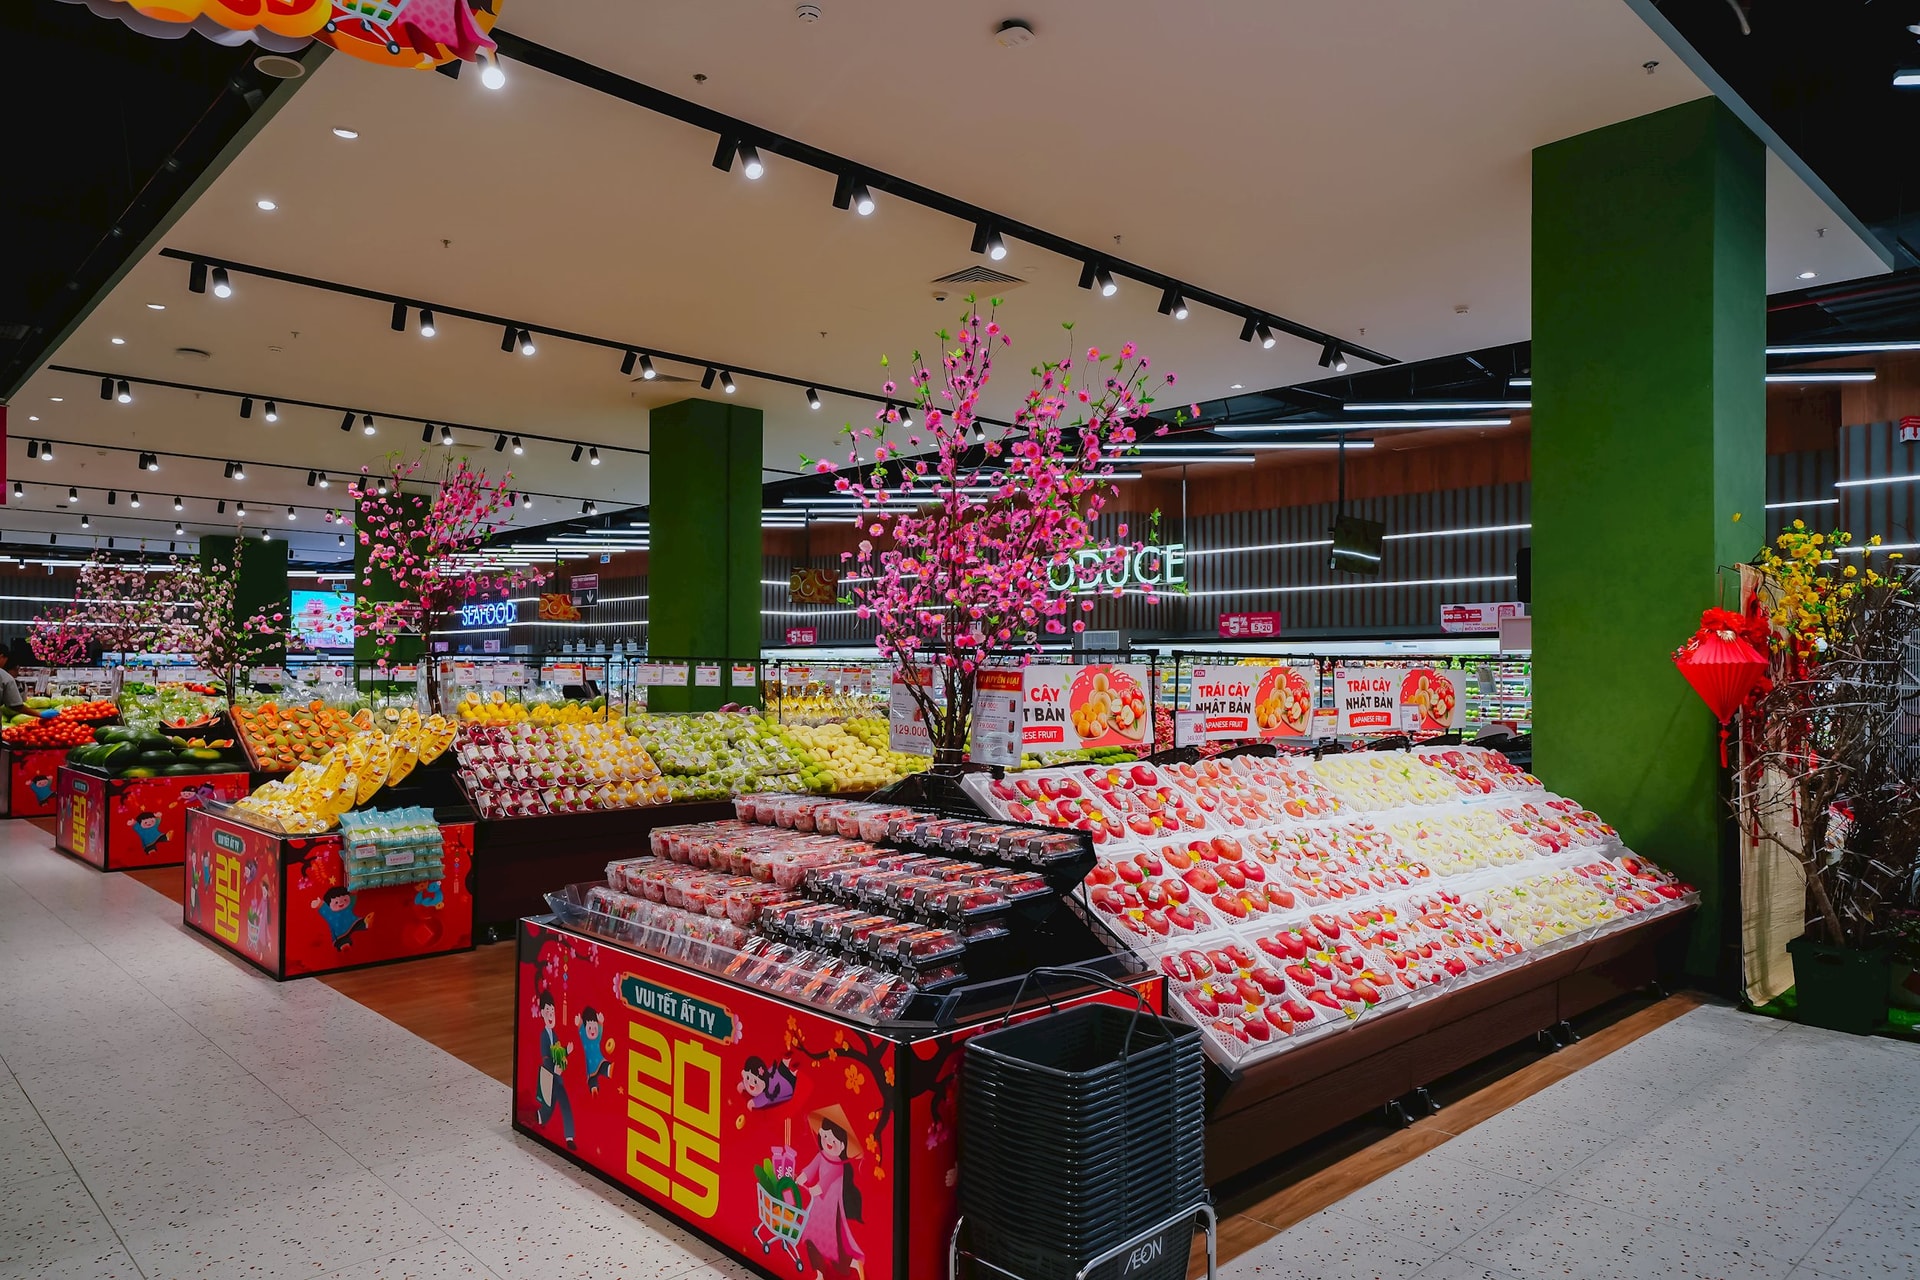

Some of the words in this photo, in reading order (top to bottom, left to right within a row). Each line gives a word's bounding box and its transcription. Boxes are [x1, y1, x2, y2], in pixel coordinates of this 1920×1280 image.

[462, 602, 514, 626] SEAFOOD
[1030, 684, 1060, 702] CÂY
[1199, 681, 1224, 698] TRÁI
[1228, 681, 1250, 697] CÂY
[1347, 677, 1370, 692] TRÁI
[1372, 677, 1391, 692] CÂY
[1229, 696, 1251, 714] BẢN
[1346, 693, 1372, 712] NHẬT
[1374, 692, 1393, 709] BẢN
[1035, 702, 1065, 722] BẢN
[1206, 721, 1228, 729] APANESE
[1229, 720, 1244, 728] FRUIT
[1038, 730, 1057, 739] FRUIT
[635, 985, 655, 1010] VUI
[657, 991, 677, 1017] TẾT
[680, 998, 696, 1024] ẤT
[699, 1008, 716, 1034] TỴ
